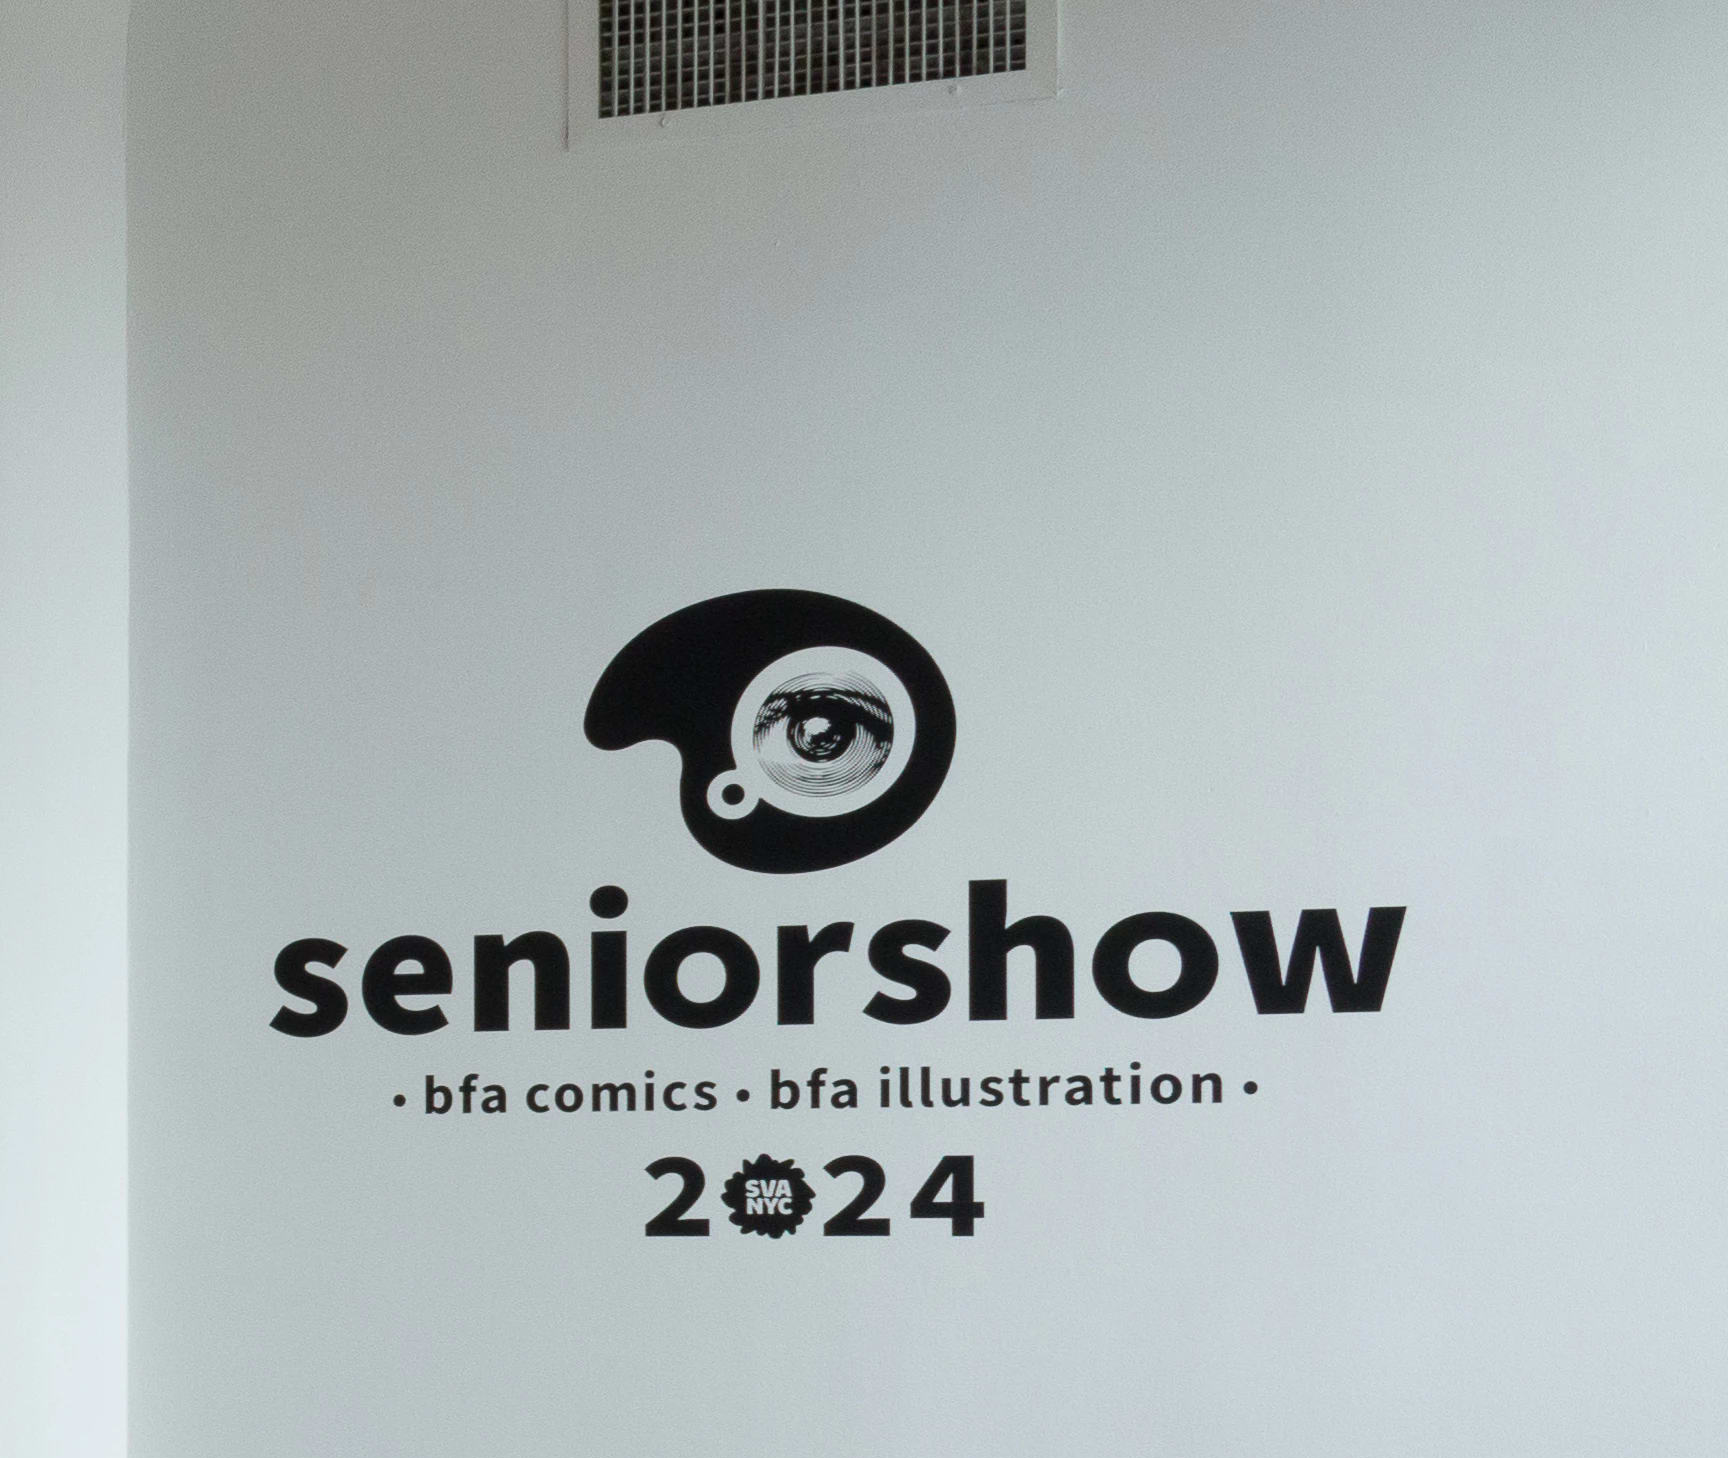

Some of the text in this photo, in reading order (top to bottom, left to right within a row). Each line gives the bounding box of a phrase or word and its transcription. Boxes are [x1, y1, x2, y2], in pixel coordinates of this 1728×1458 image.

[269, 879, 1407, 1038] seniorshow
[425, 1061, 1223, 1115] bfa comics bfa illustration
[744, 1179, 793, 1198] SVA
[745, 1197, 793, 1216] NYC
